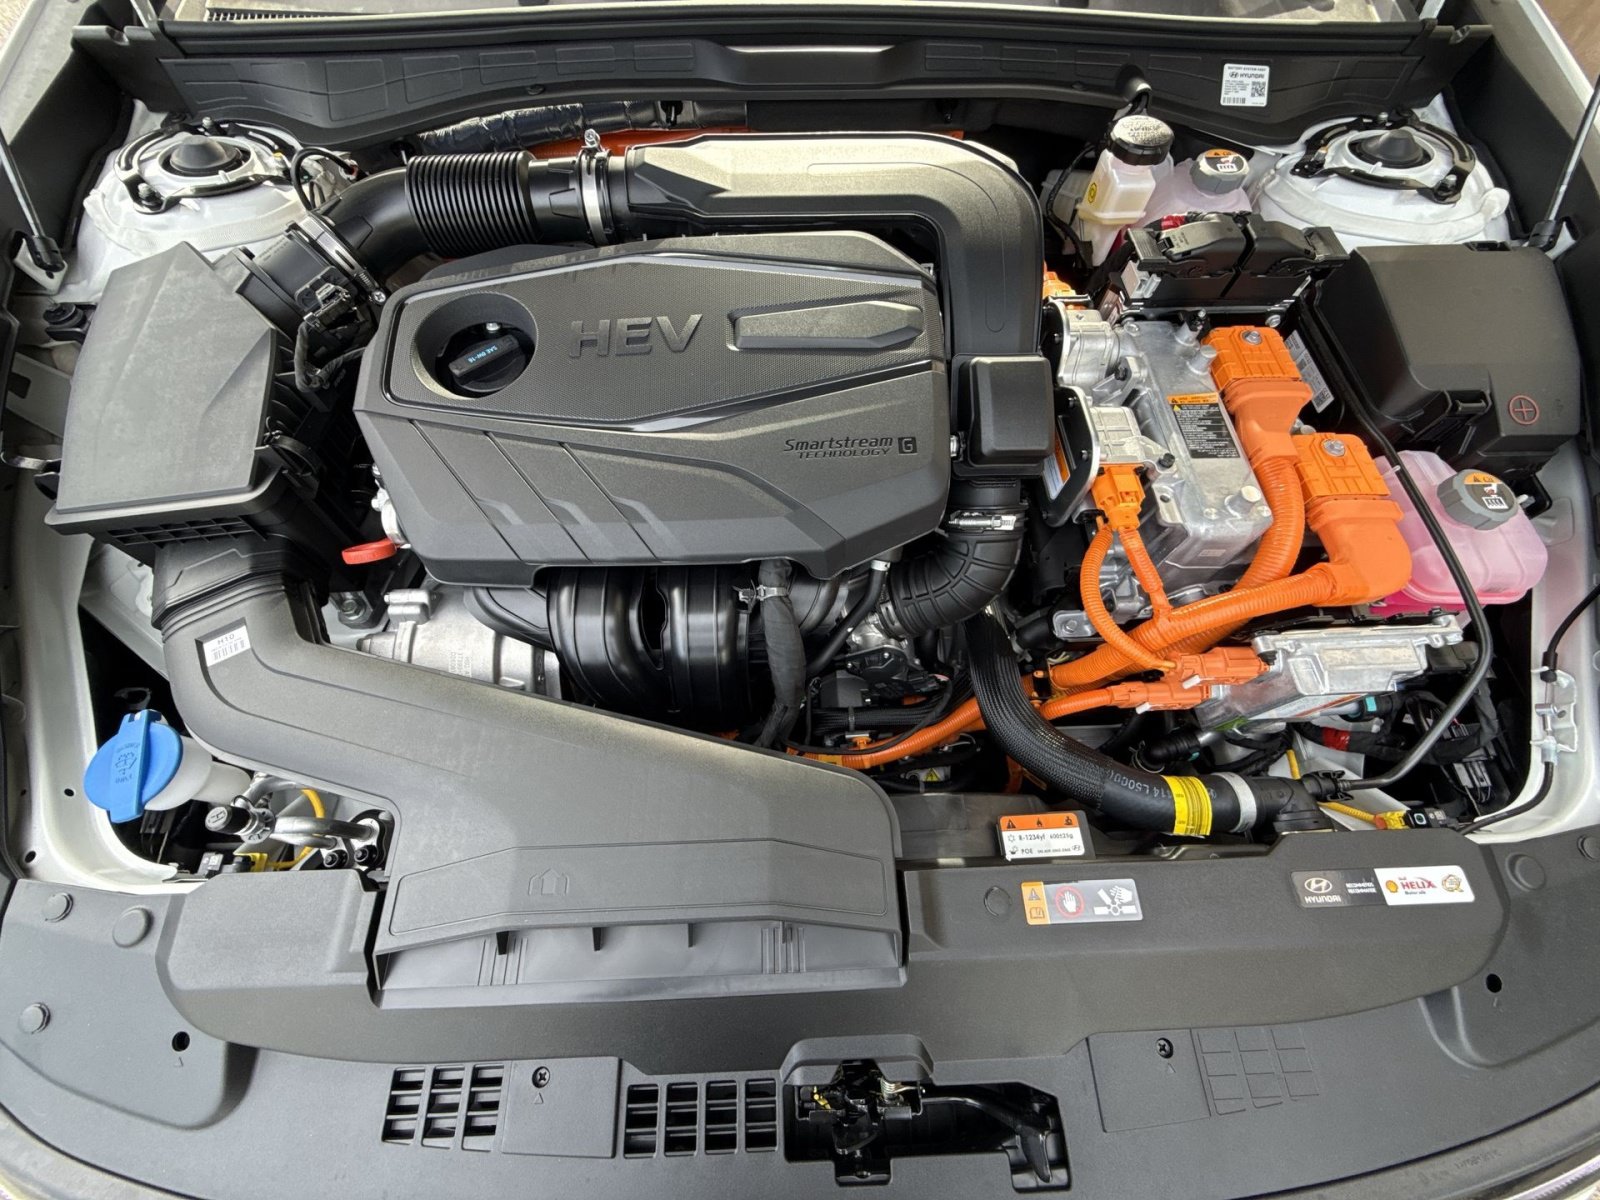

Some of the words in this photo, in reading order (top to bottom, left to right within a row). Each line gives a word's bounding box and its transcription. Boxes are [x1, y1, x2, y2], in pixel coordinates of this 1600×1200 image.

[569, 313, 703, 358] HEV
[783, 437, 893, 452] Smartstream
[899, 437, 917, 454] G
[797, 448, 891, 459] TECHNOLOGY
[1018, 833, 1046, 841] R-1234yf
[1400, 880, 1437, 890] HELIX
[1304, 894, 1342, 904] HYUNDAI
